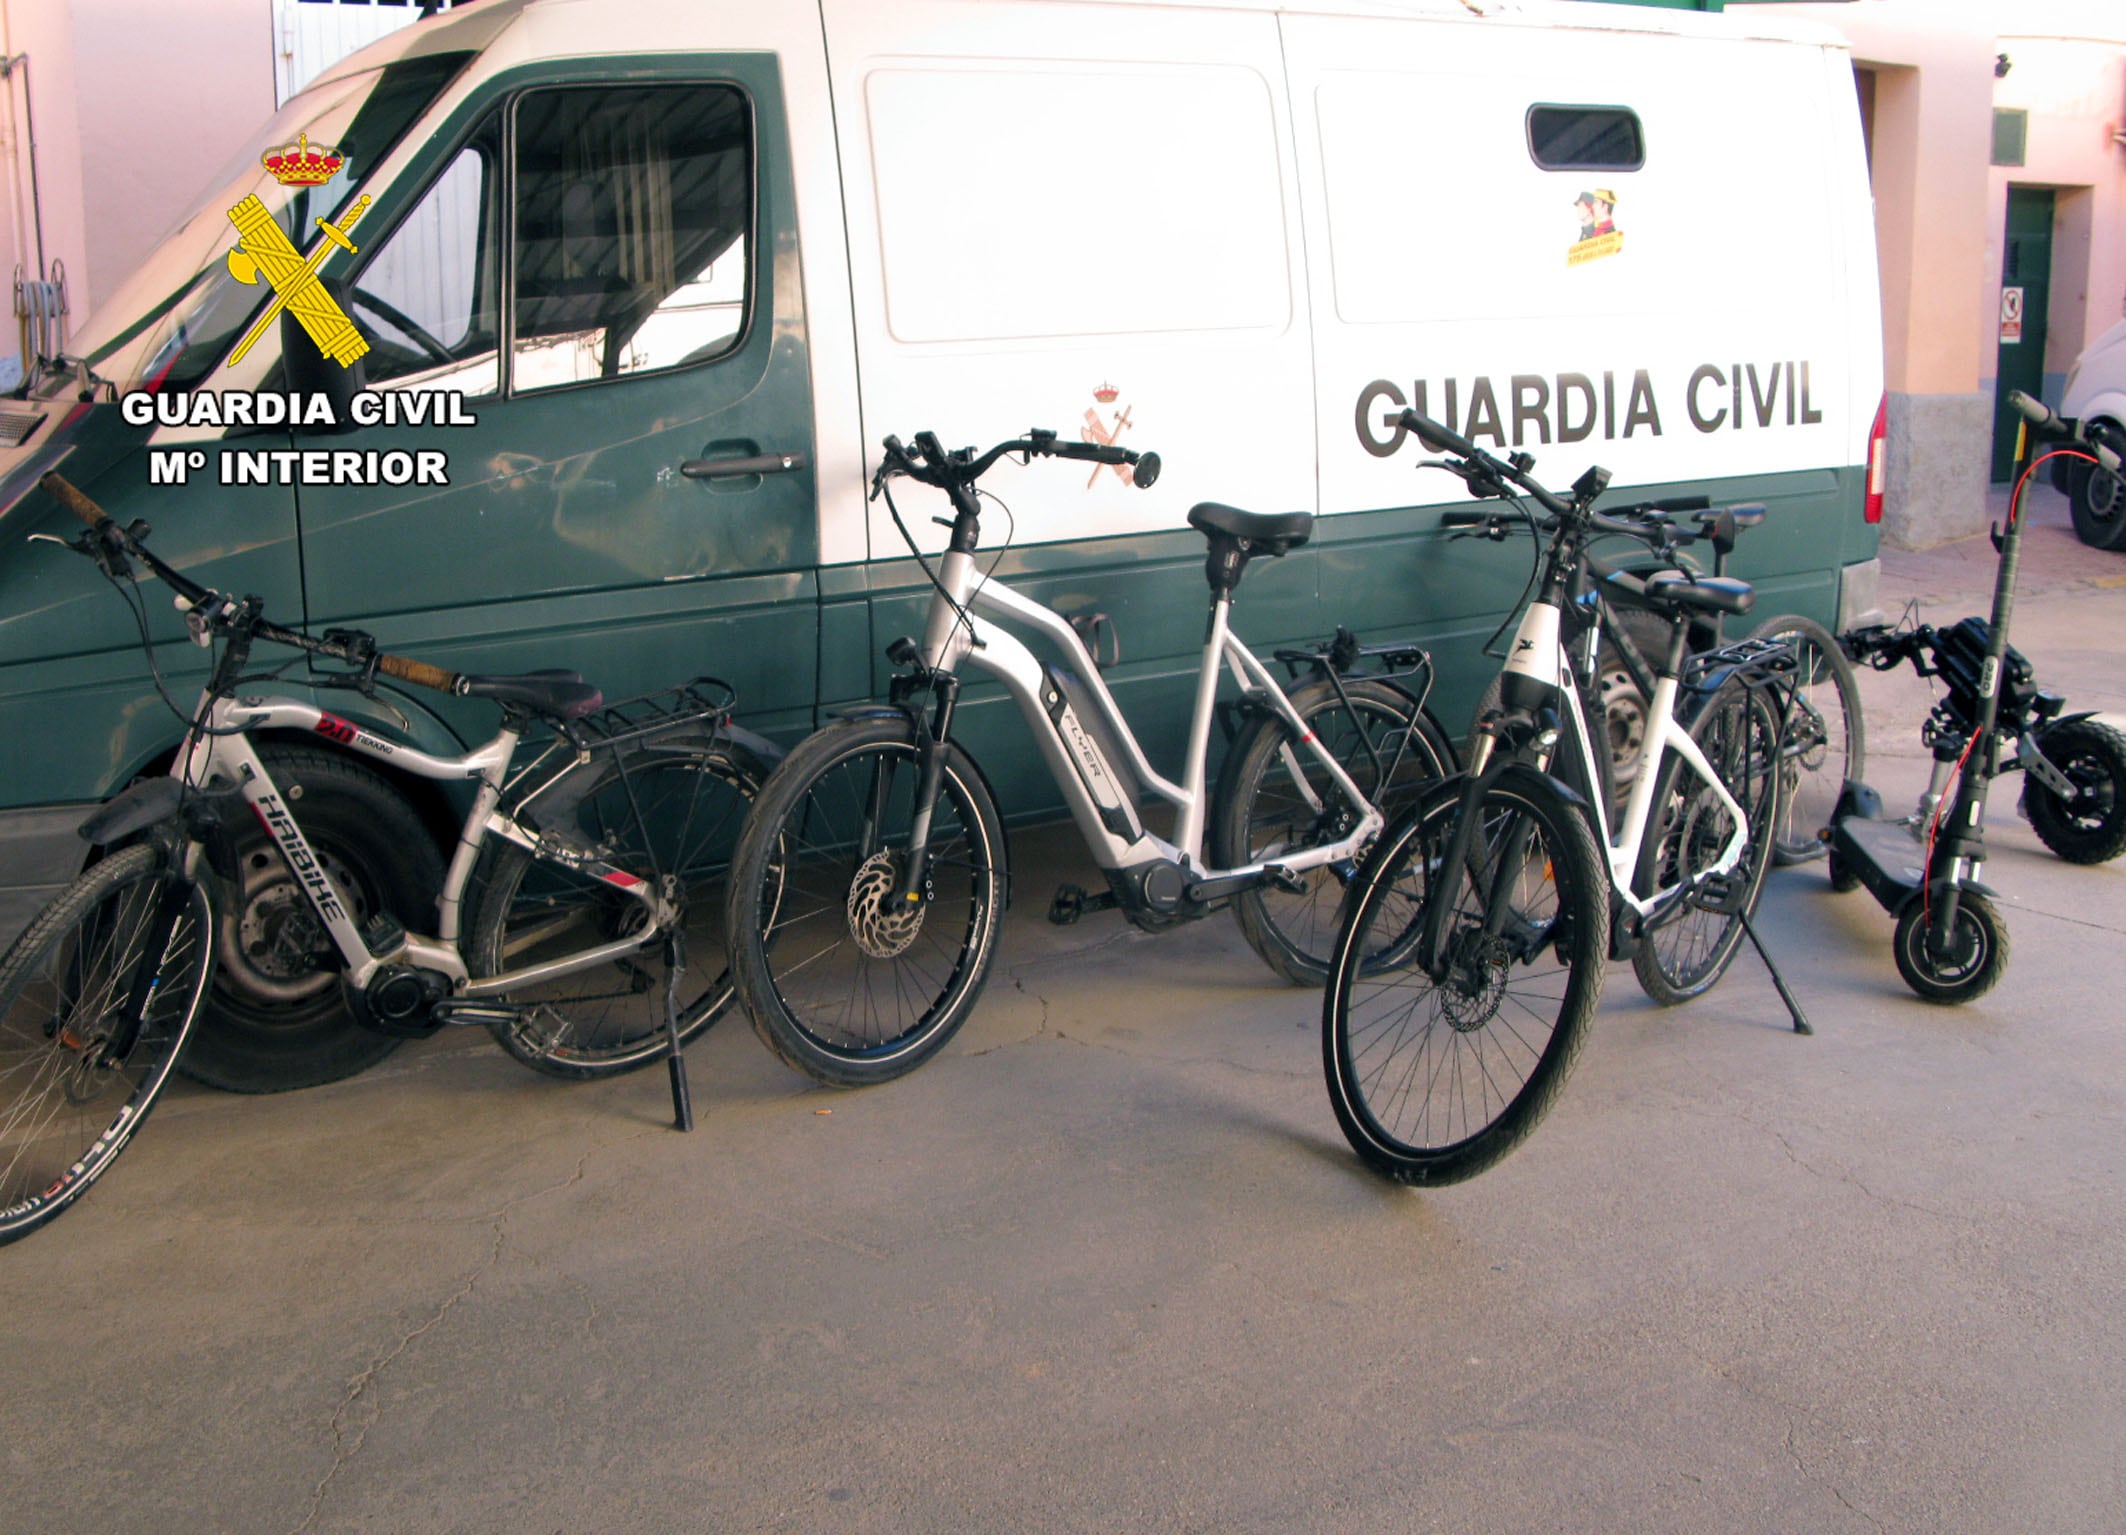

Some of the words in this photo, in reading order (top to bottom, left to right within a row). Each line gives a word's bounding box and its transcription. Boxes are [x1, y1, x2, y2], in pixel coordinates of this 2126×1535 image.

[1355, 368, 1662, 457] GUARDIA
[1687, 361, 1822, 434] CIVIL
[318, 717, 355, 743] 2.0
[1065, 714, 1101, 777] FLYER
